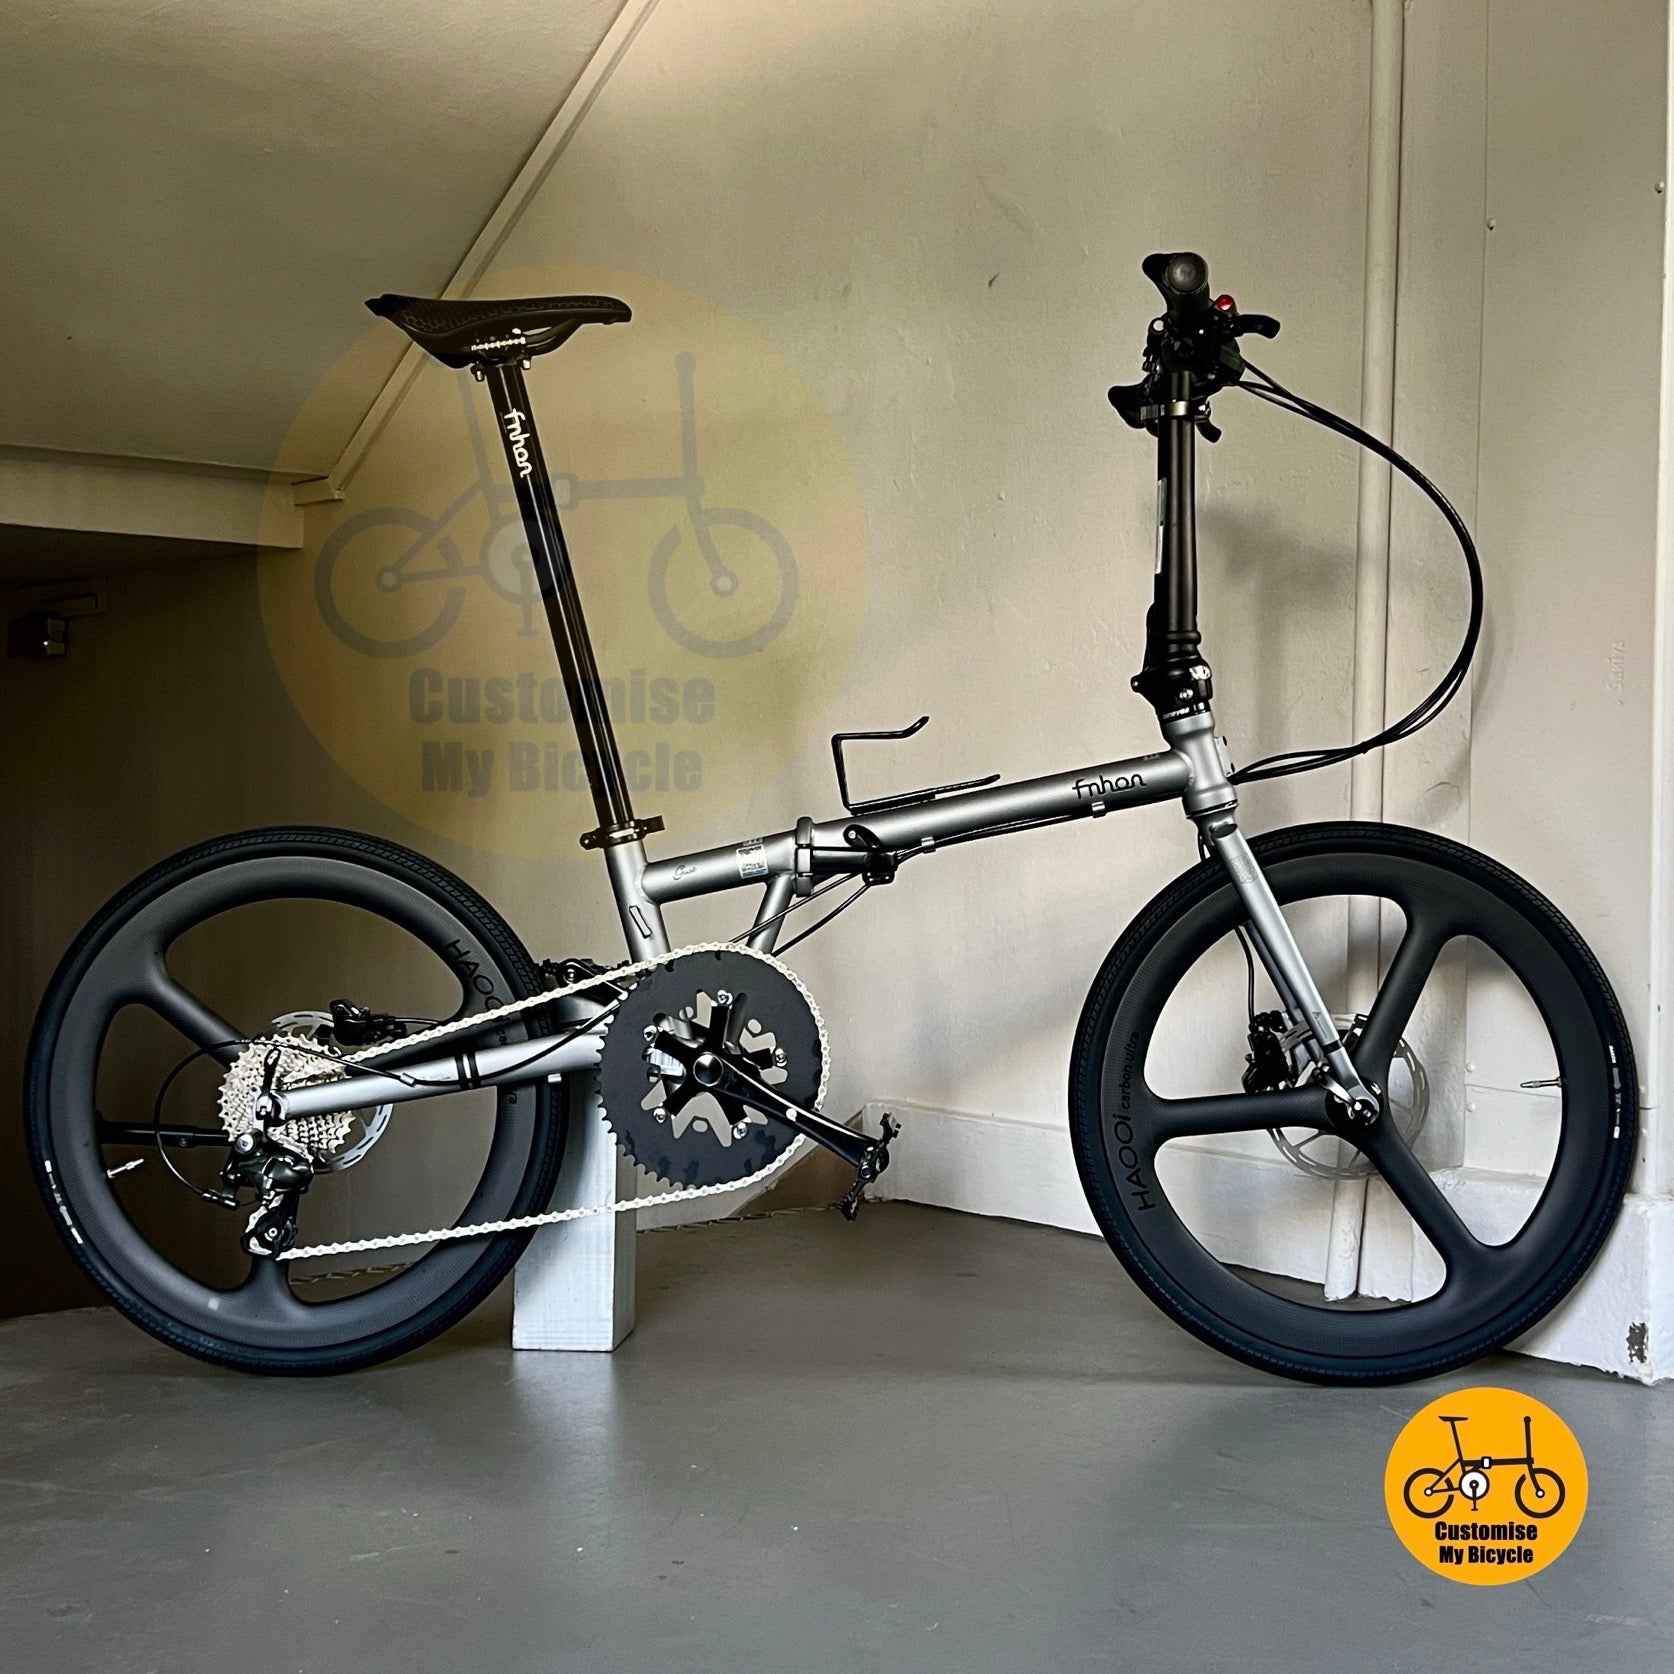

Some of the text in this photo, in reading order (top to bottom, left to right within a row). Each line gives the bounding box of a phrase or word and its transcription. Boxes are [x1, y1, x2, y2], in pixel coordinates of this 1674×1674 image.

[1072, 774, 1147, 799] fnhon
[1124, 1031, 1140, 1061] ultra
[1118, 1064, 1133, 1110] carbon
